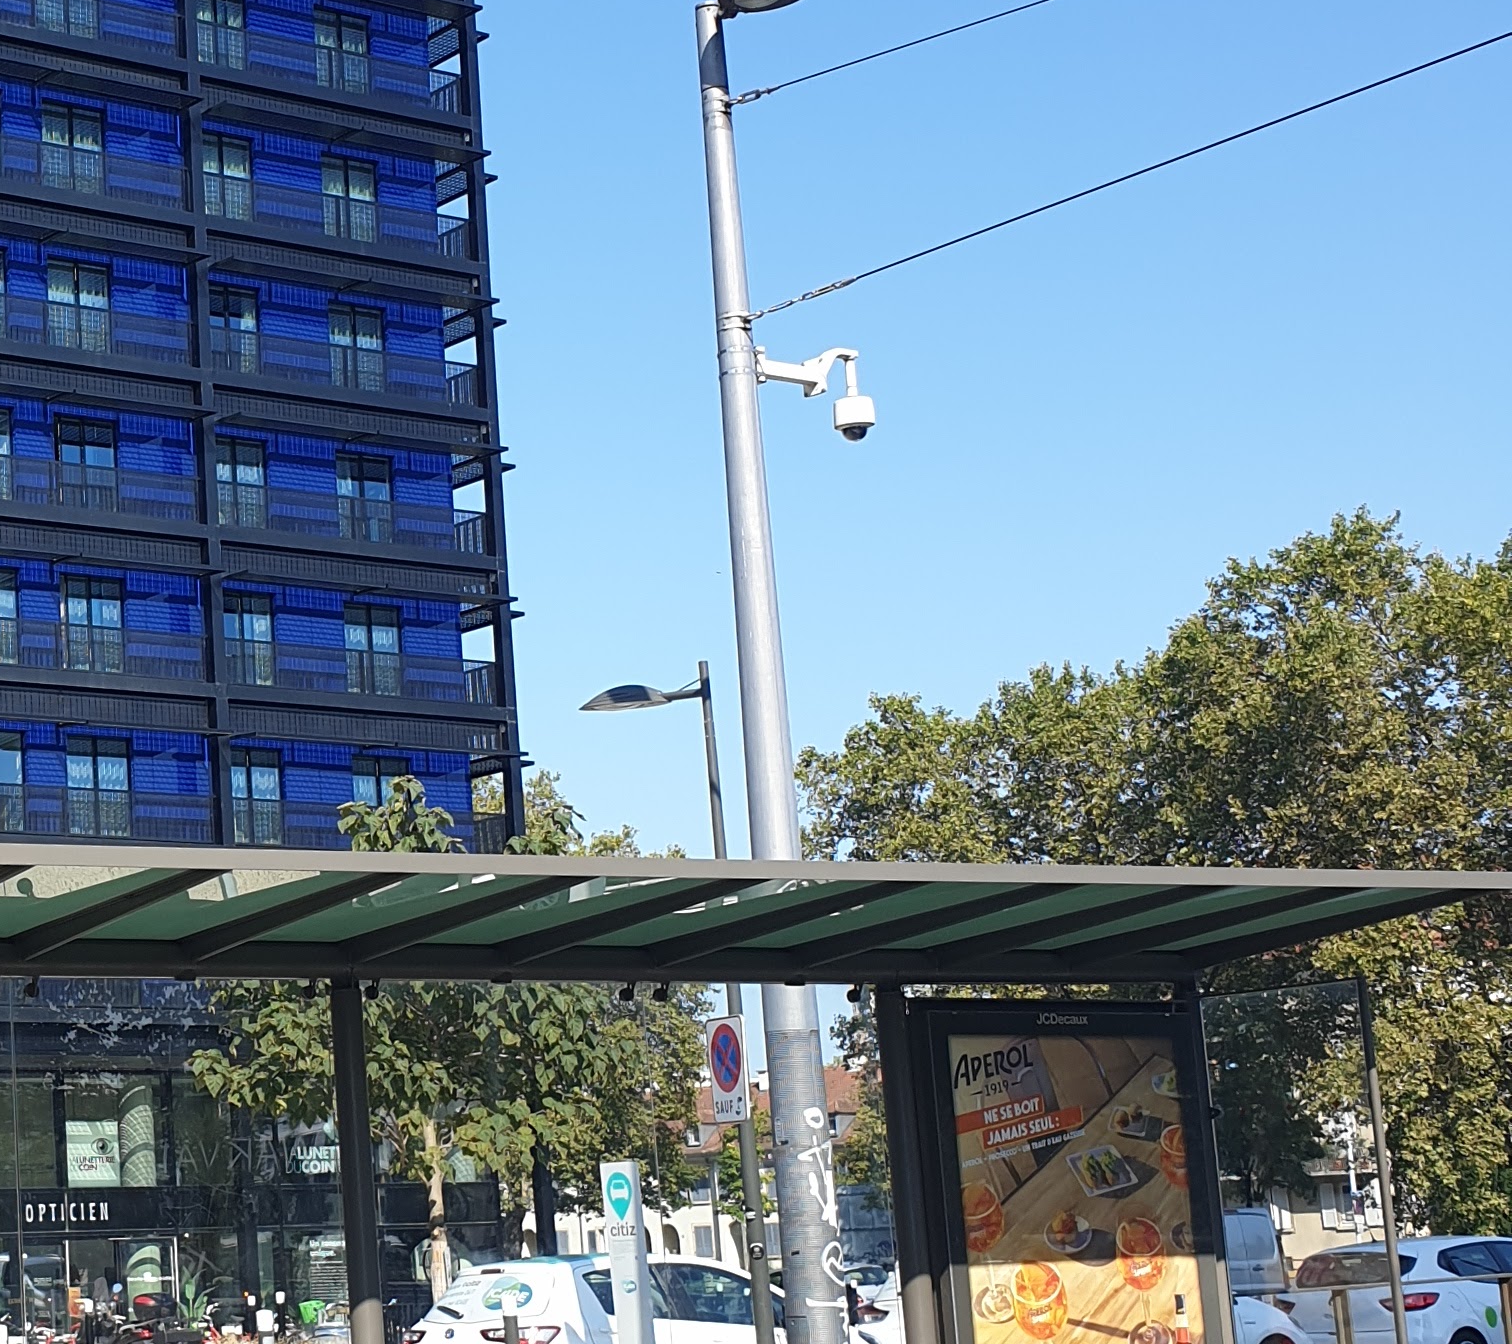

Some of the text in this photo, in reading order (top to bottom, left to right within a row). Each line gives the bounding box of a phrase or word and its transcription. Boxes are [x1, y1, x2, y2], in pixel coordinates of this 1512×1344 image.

[1036, 1012, 1088, 1025] JCDecaux
[954, 1043, 1034, 1089] APEROL
[984, 1080, 1009, 1096] 1919
[715, 1099, 734, 1115] SAUF
[983, 1097, 1040, 1125] NE SE BOIT
[987, 1121, 1028, 1146] JAMAIS
[25, 1202, 109, 1223] OPTICIEN
[610, 1221, 637, 1236] citiz
